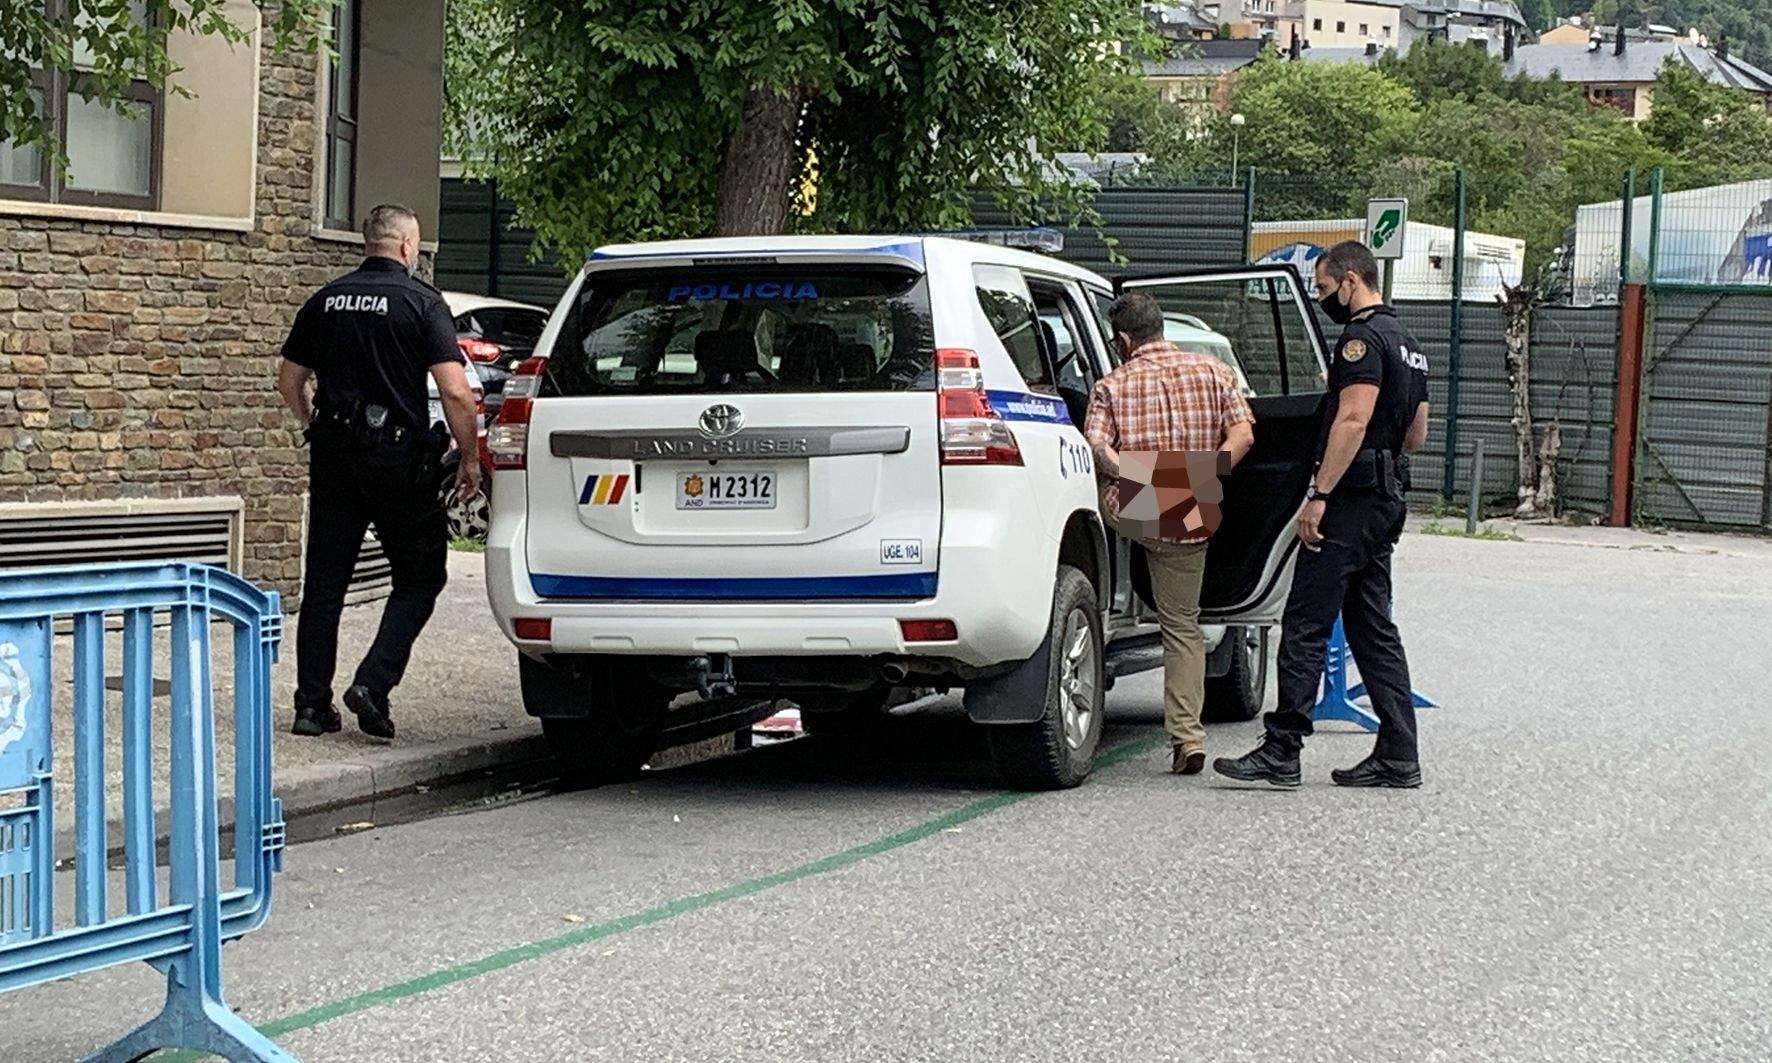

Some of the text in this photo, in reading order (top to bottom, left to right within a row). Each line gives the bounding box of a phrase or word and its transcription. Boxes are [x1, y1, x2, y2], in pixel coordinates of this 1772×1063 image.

[668, 282, 818, 301] POLICIA
[324, 294, 388, 313] POLICIA
[633, 438, 807, 455] LAND CRUISER
[1069, 444, 1091, 474] 110
